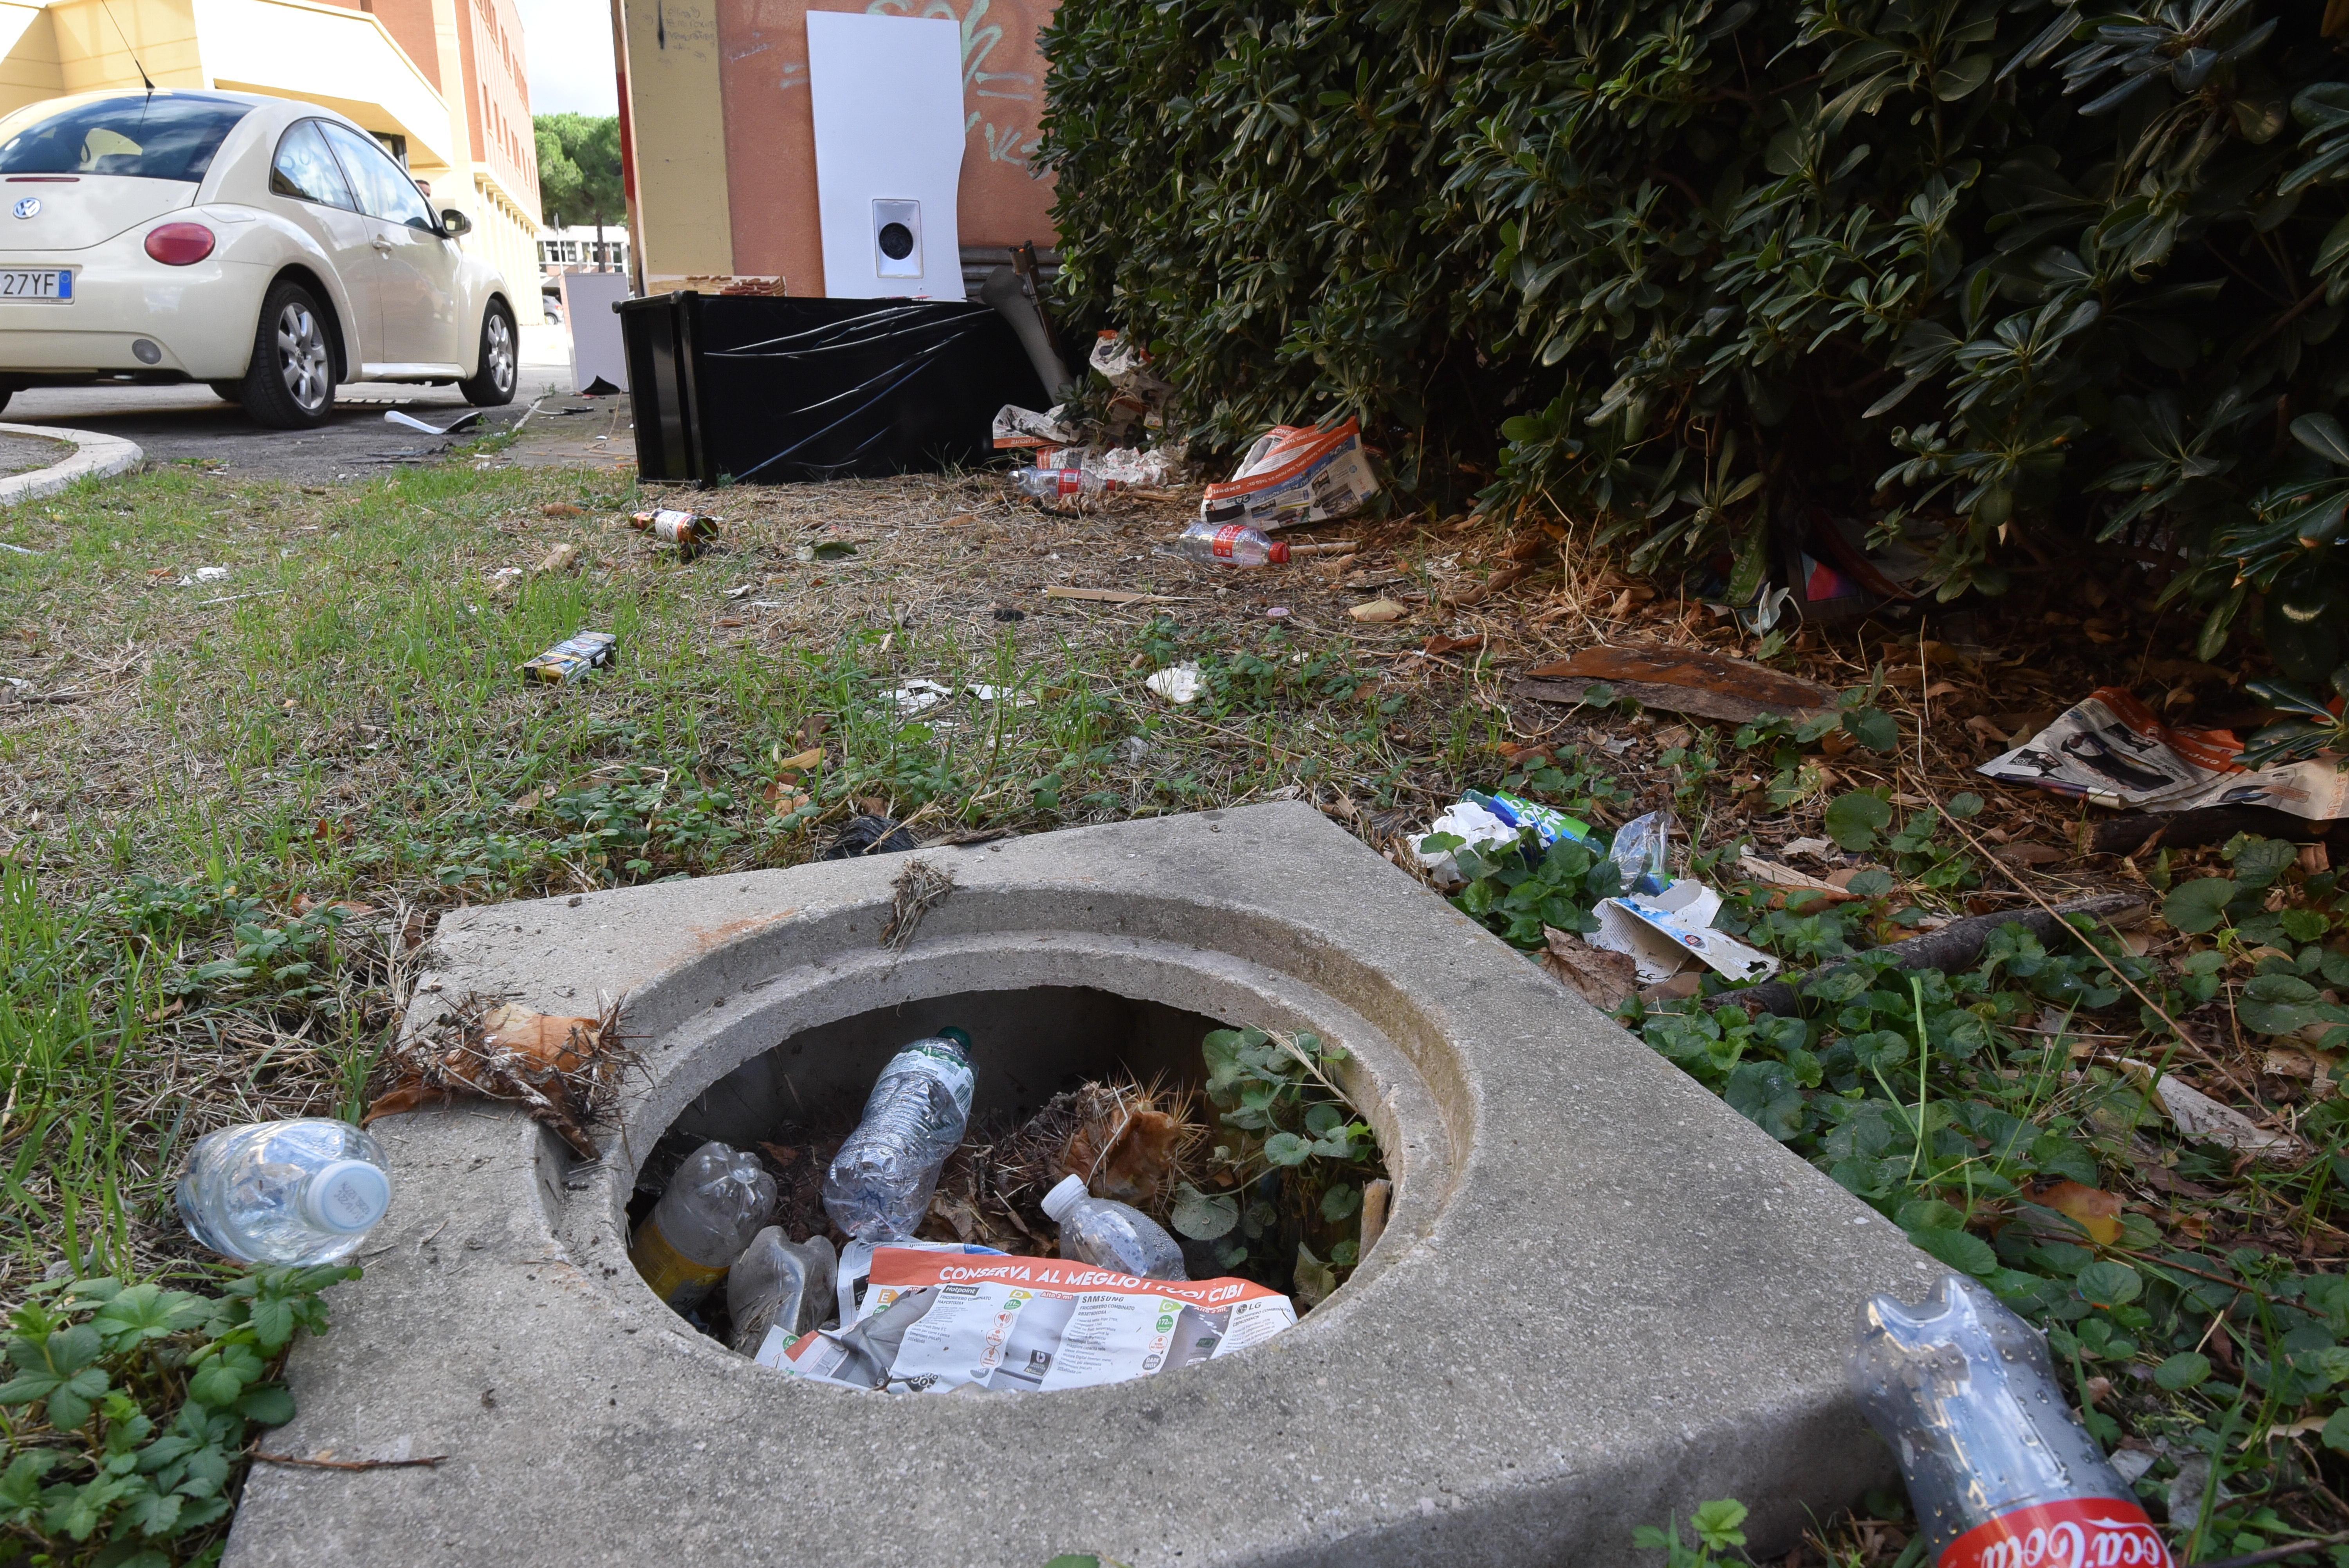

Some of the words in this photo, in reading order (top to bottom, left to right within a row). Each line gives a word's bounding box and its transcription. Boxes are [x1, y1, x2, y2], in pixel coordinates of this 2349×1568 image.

[0, 273, 56, 296] 27YF
[1212, 485, 1241, 494] expert
[2162, 764, 2190, 781] EPSON
[939, 1266, 1031, 1281] CONSERVA
[1035, 1269, 1061, 1284] AL
[1064, 1271, 1140, 1288] MEGLIO
[1208, 1283, 1246, 1303] CIBI
[945, 1286, 976, 1294] Hotpoint
[880, 1292, 891, 1303] E
[1082, 1295, 1124, 1303] SAMSUNG
[1162, 1302, 1173, 1311] C
[1249, 1302, 1262, 1310] LG
